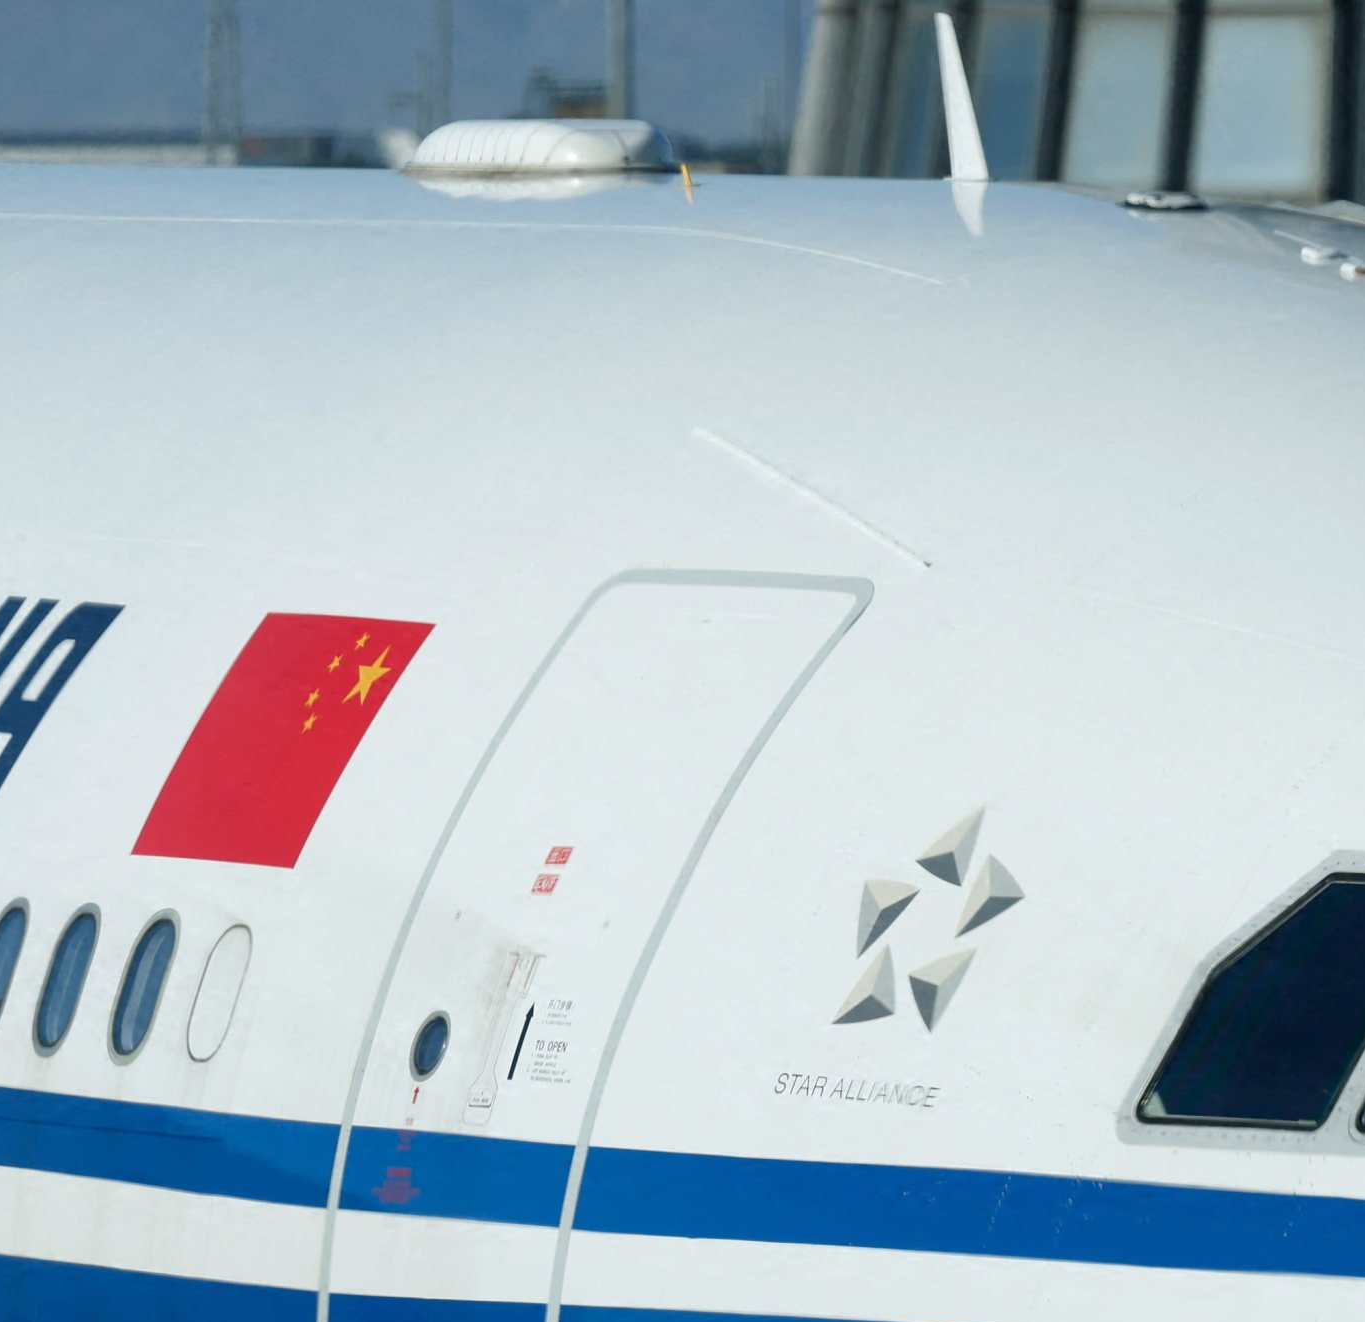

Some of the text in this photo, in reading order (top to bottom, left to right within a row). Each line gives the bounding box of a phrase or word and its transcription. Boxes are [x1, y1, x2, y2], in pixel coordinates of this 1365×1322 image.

[535, 1039, 568, 1053] TO OPEN
[774, 1072, 942, 1108] STAR ALLIANCE
